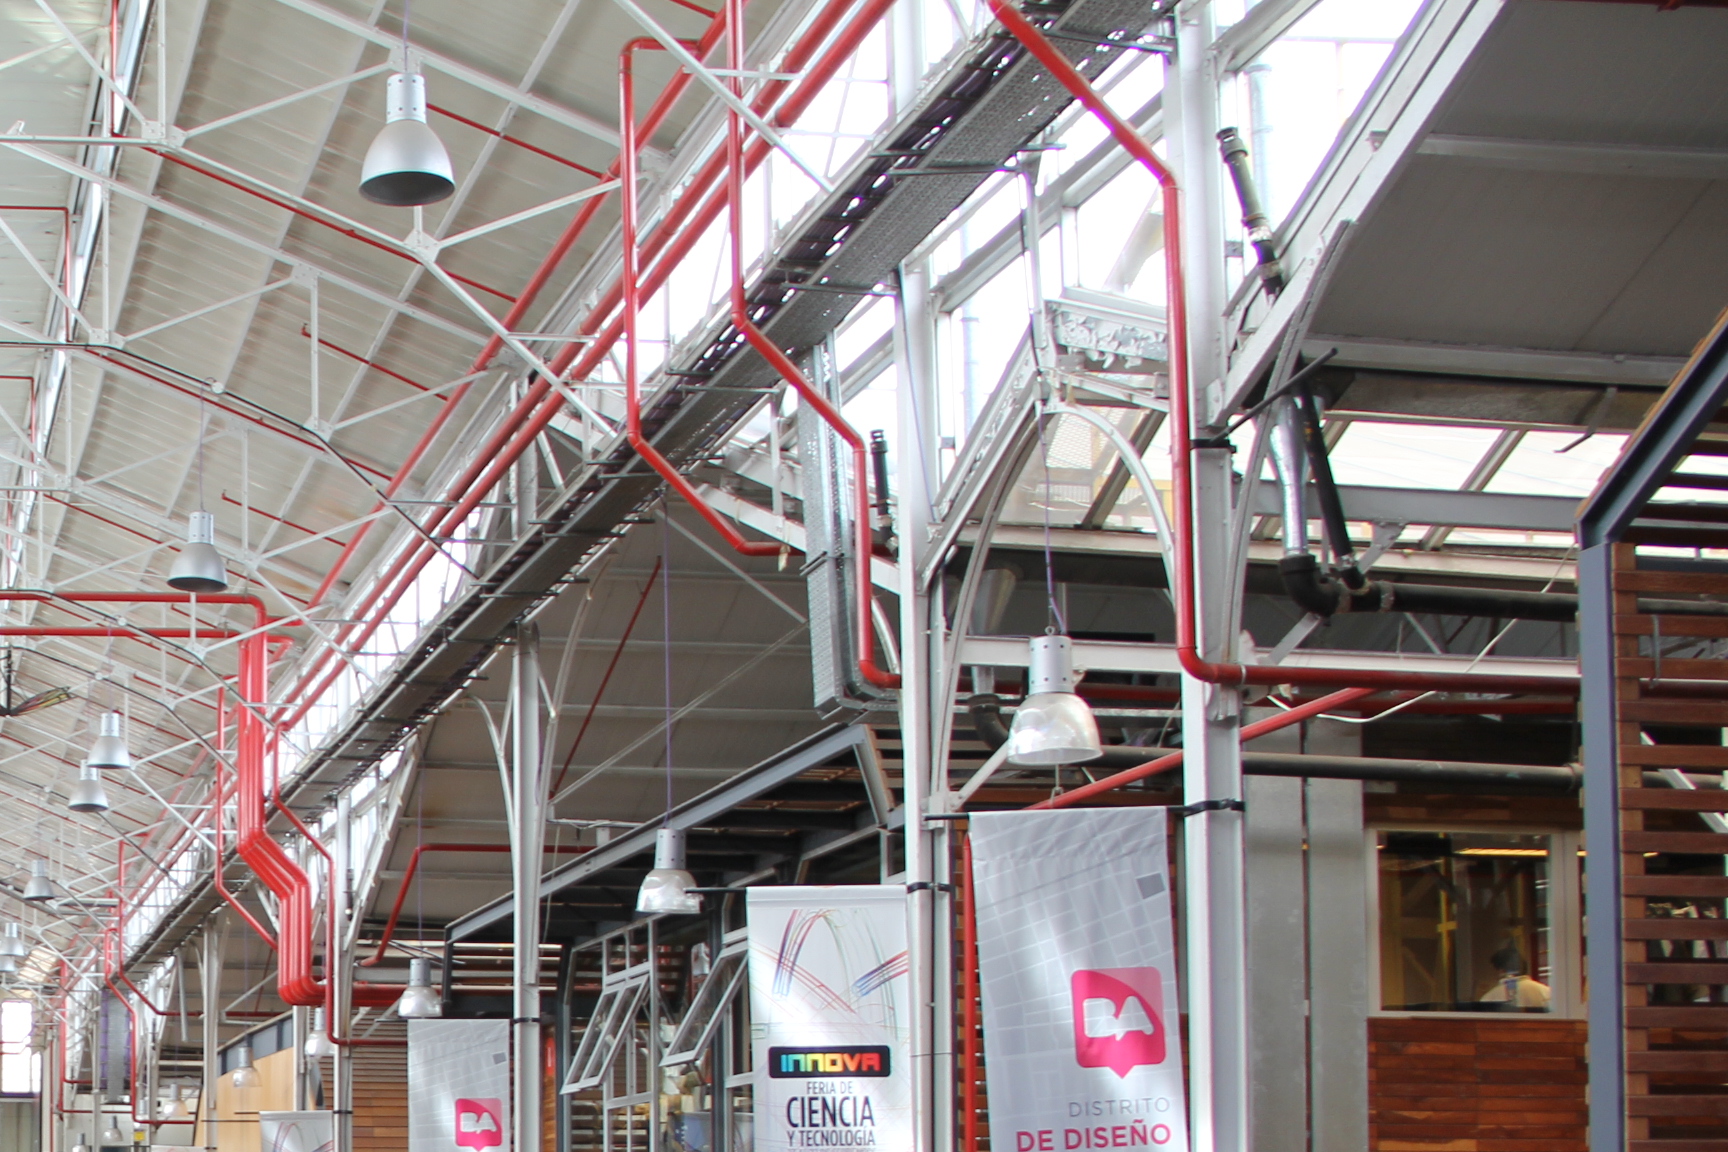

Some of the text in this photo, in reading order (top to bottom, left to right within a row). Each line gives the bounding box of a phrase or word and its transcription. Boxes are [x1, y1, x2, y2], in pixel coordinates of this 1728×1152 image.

[1083, 995, 1155, 1041] BA
[780, 1052, 881, 1072] INNOVA
[806, 1081, 853, 1094] FERIA DE
[786, 1096, 875, 1128] CIENCIA
[1068, 1097, 1170, 1118] DISTRITO
[786, 1126, 876, 1147] Y TECNOLOGÍA
[1016, 1119, 1171, 1152] DE DISEÑO
